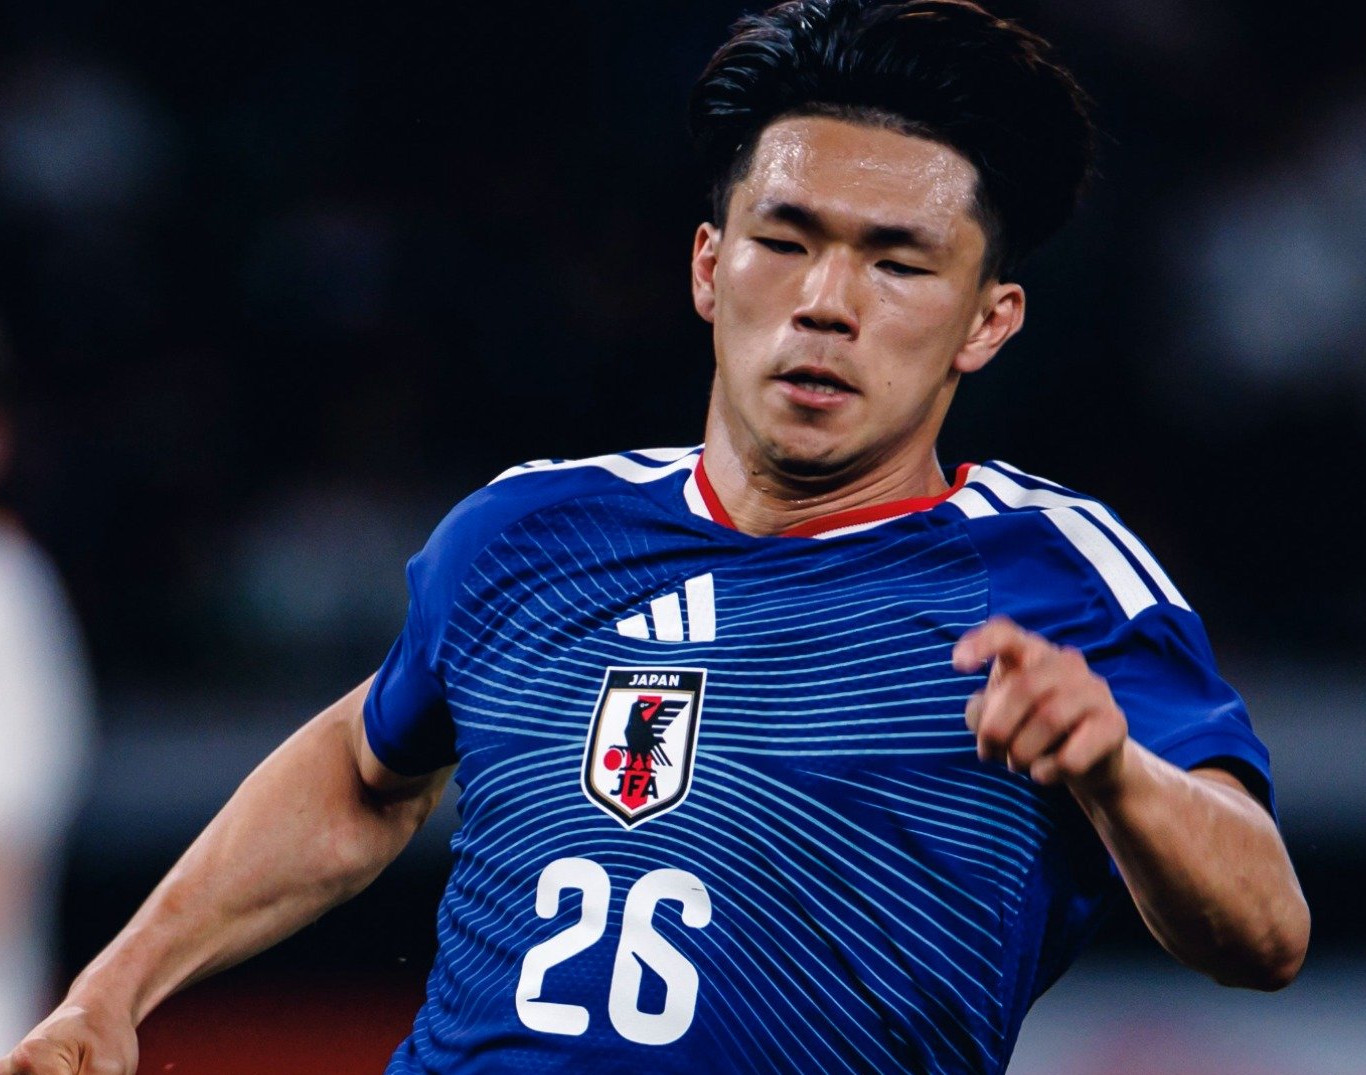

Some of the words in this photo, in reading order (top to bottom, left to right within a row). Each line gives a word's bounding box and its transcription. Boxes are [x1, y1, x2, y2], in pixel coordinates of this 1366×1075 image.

[628, 673, 681, 687] JAPAN
[609, 773, 659, 799] JFA
[515, 857, 712, 1046] 26
